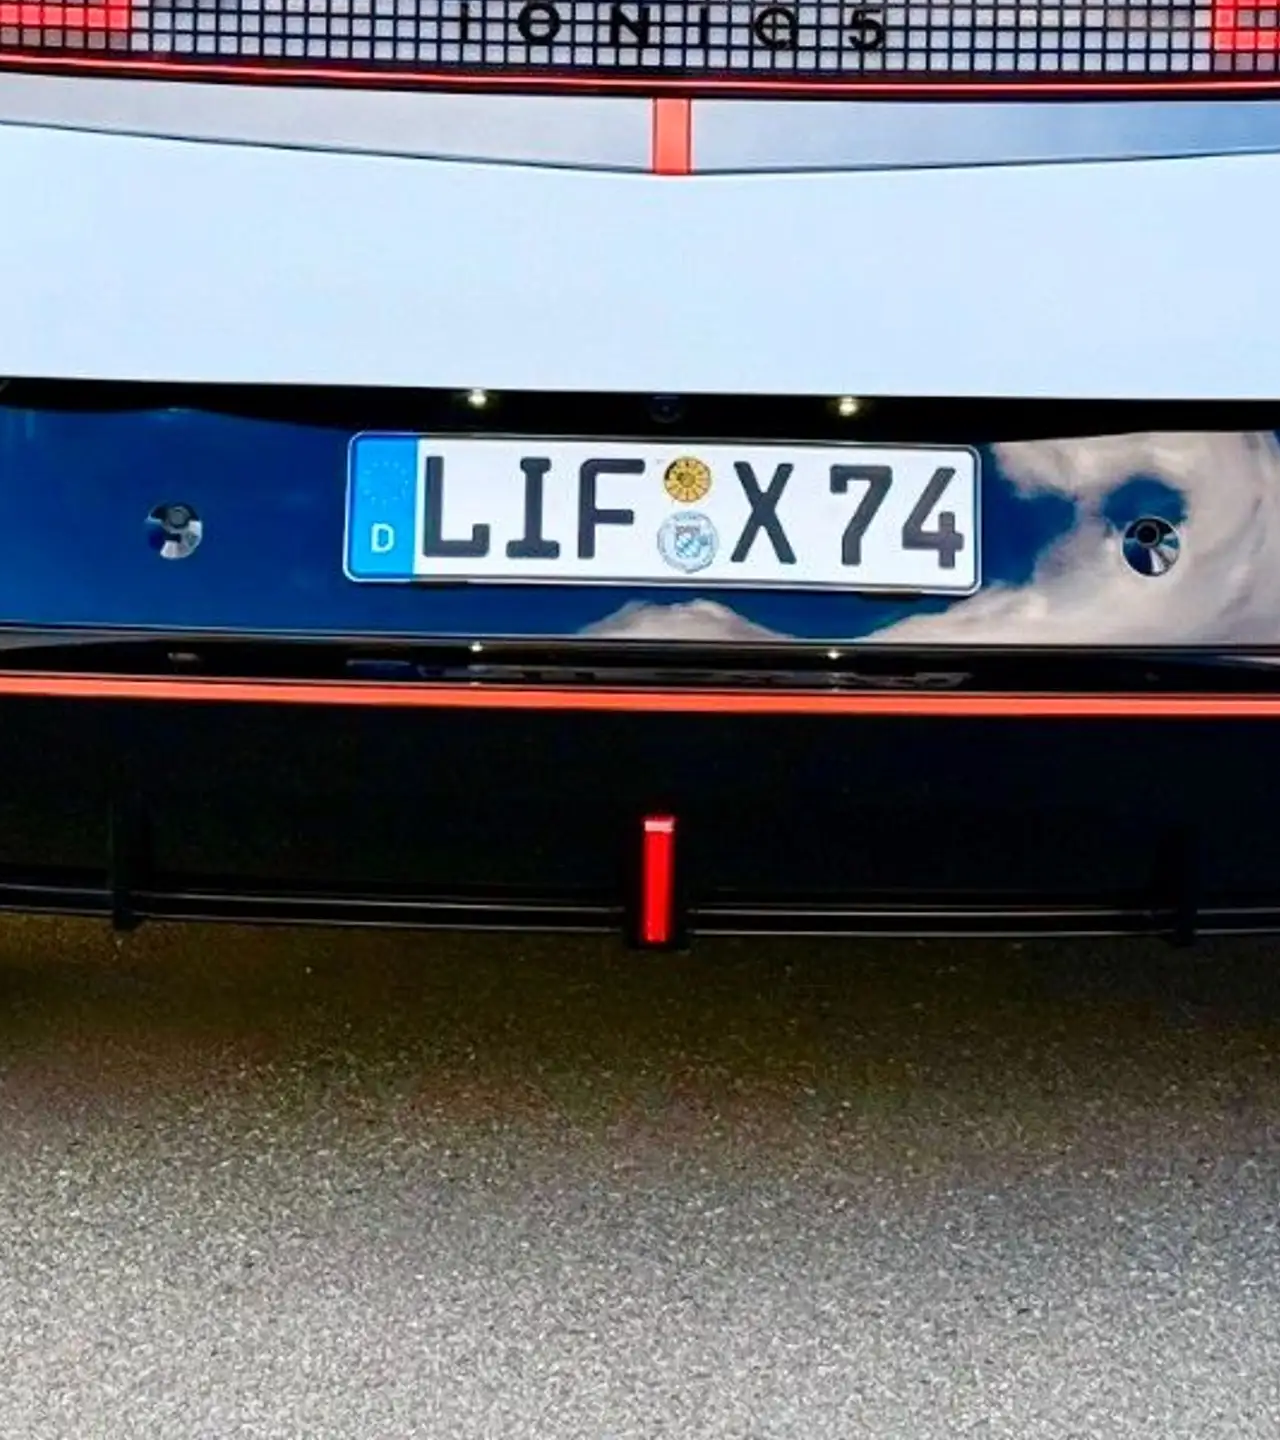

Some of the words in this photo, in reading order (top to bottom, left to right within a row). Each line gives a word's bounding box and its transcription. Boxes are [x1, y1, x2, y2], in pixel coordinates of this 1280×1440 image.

[460, 1, 798, 50] IONIQ
[848, 8, 885, 52] 5
[422, 455, 646, 559] LIF
[730, 460, 797, 564] X
[829, 464, 964, 569] 74
[370, 523, 395, 554] D
